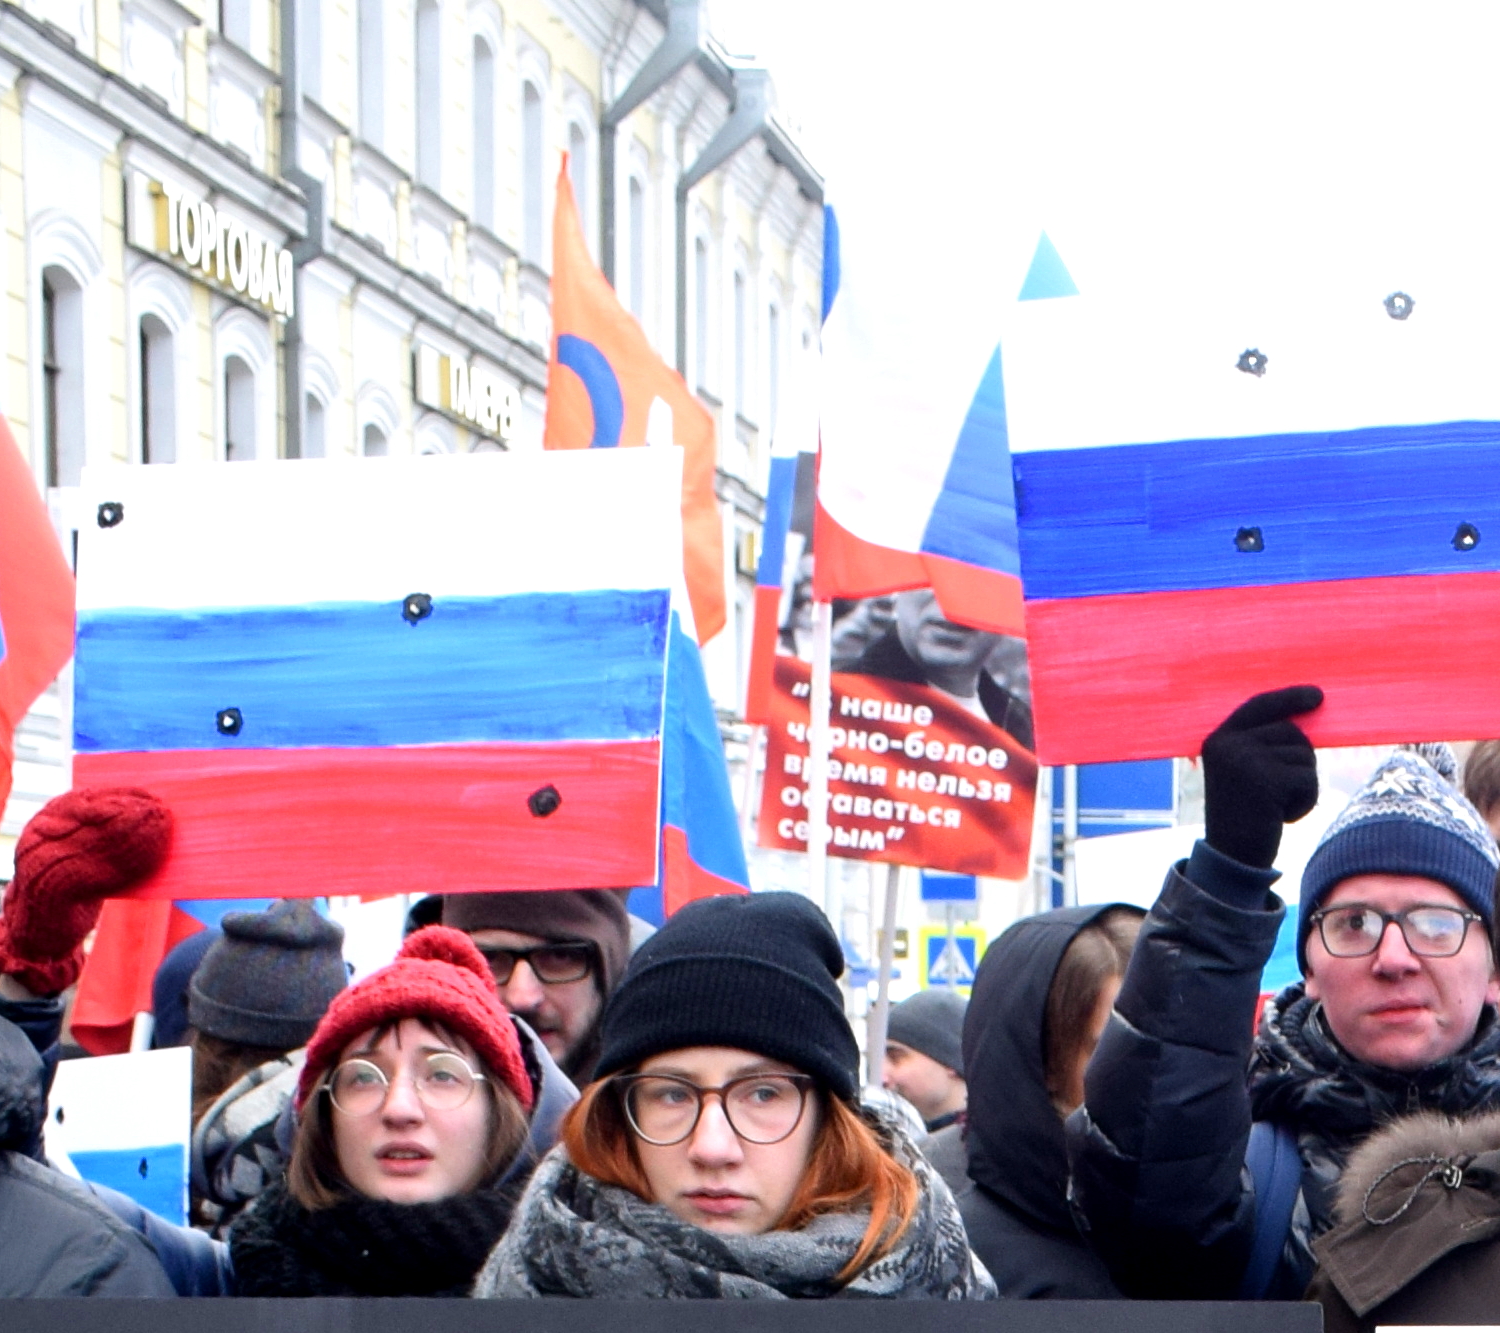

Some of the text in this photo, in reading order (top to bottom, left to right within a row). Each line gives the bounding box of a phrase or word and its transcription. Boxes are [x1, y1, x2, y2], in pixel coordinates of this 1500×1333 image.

[162, 177, 294, 318] ТОРГОВАЯ
[840, 695, 934, 726] наше
[786, 721, 1008, 769] чрно-белое
[896, 769, 1012, 803] нельзя
